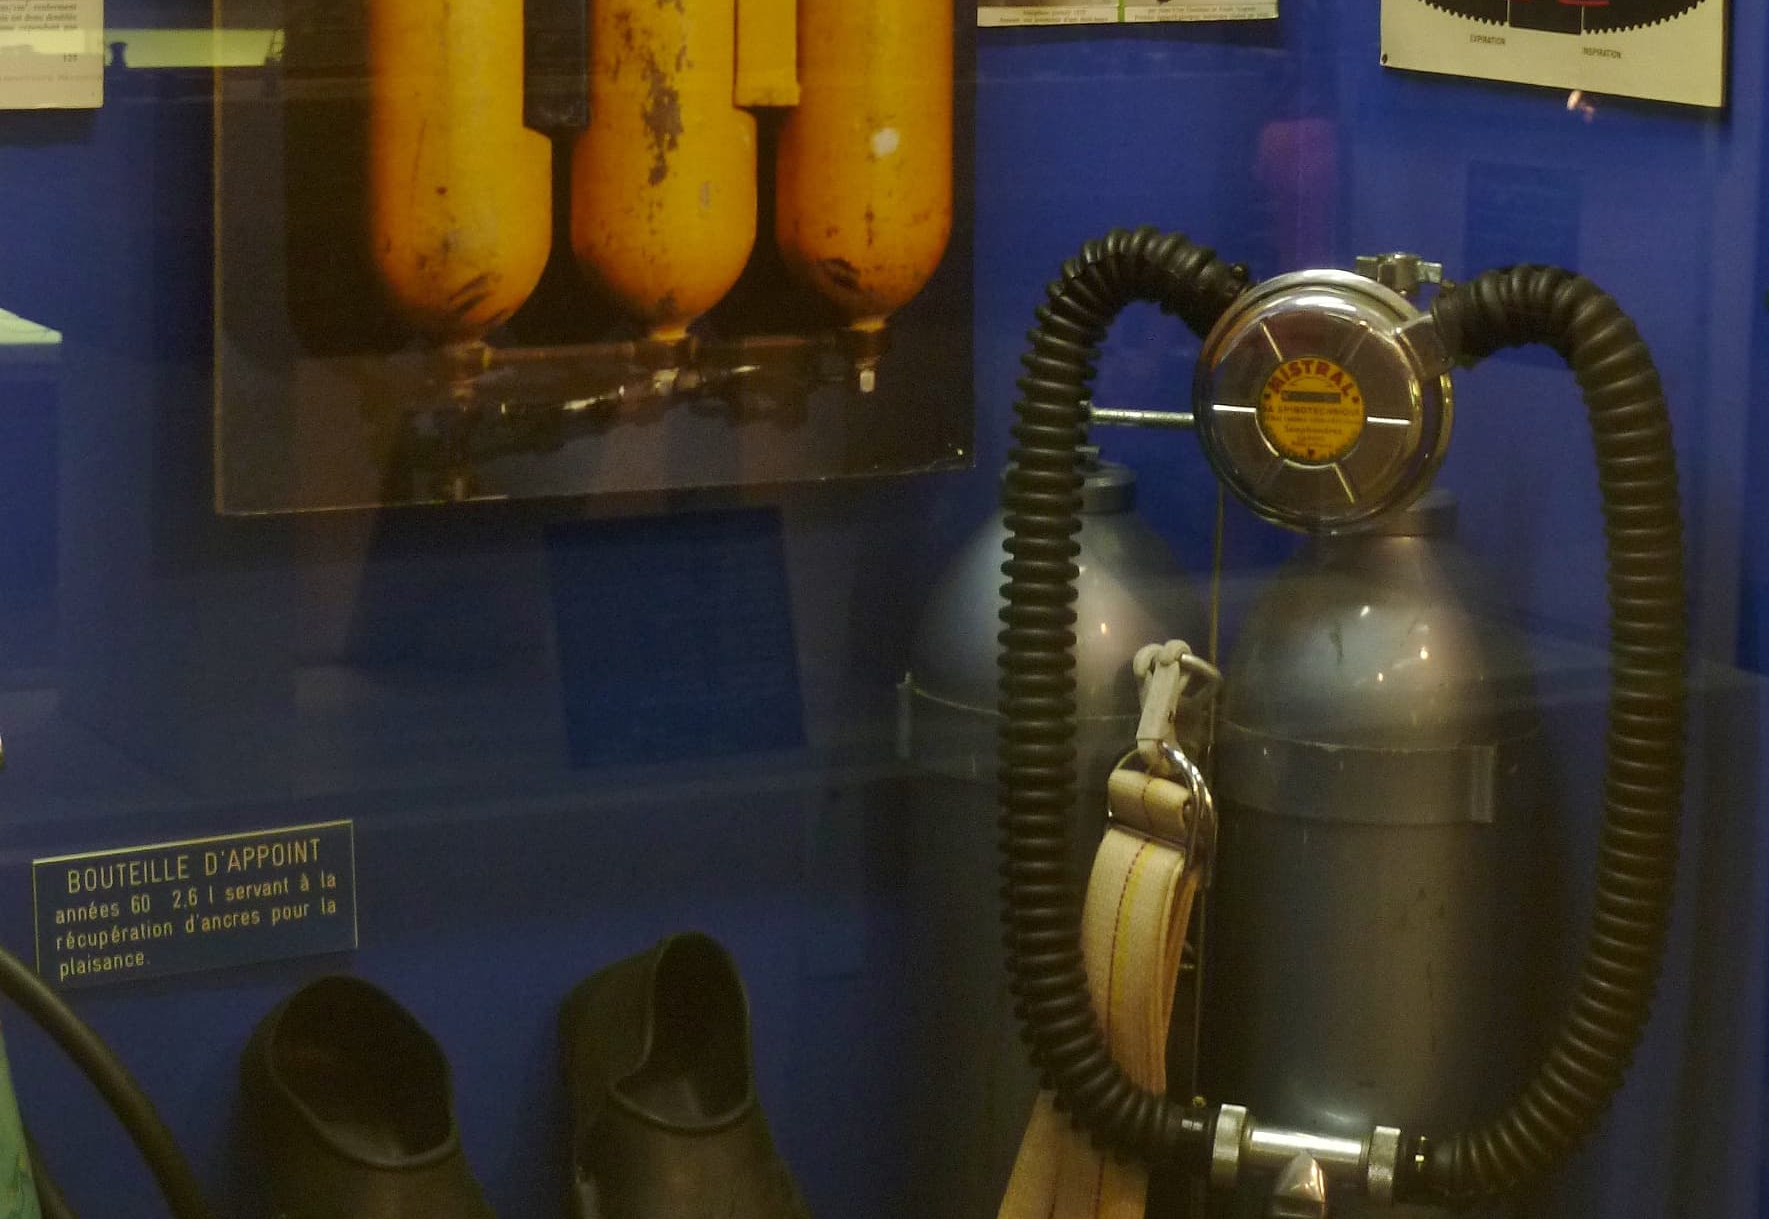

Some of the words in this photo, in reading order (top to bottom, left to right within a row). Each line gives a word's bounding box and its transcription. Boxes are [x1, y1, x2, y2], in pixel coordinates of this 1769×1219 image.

[1267, 359, 1355, 397] MISTRAL
[66, 854, 191, 895] BOUTEILLE
[204, 838, 321, 877] D'APPOINT
[55, 899, 120, 925] années
[130, 894, 151, 914] 60
[172, 887, 199, 910] 2.6
[224, 878, 290, 903] servant
[300, 873, 311, 893] à
[321, 870, 337, 889] la
[55, 918, 174, 951] récupération
[185, 910, 261, 935] d'ancres
[270, 902, 311, 927] pour
[321, 896, 337, 916] la
